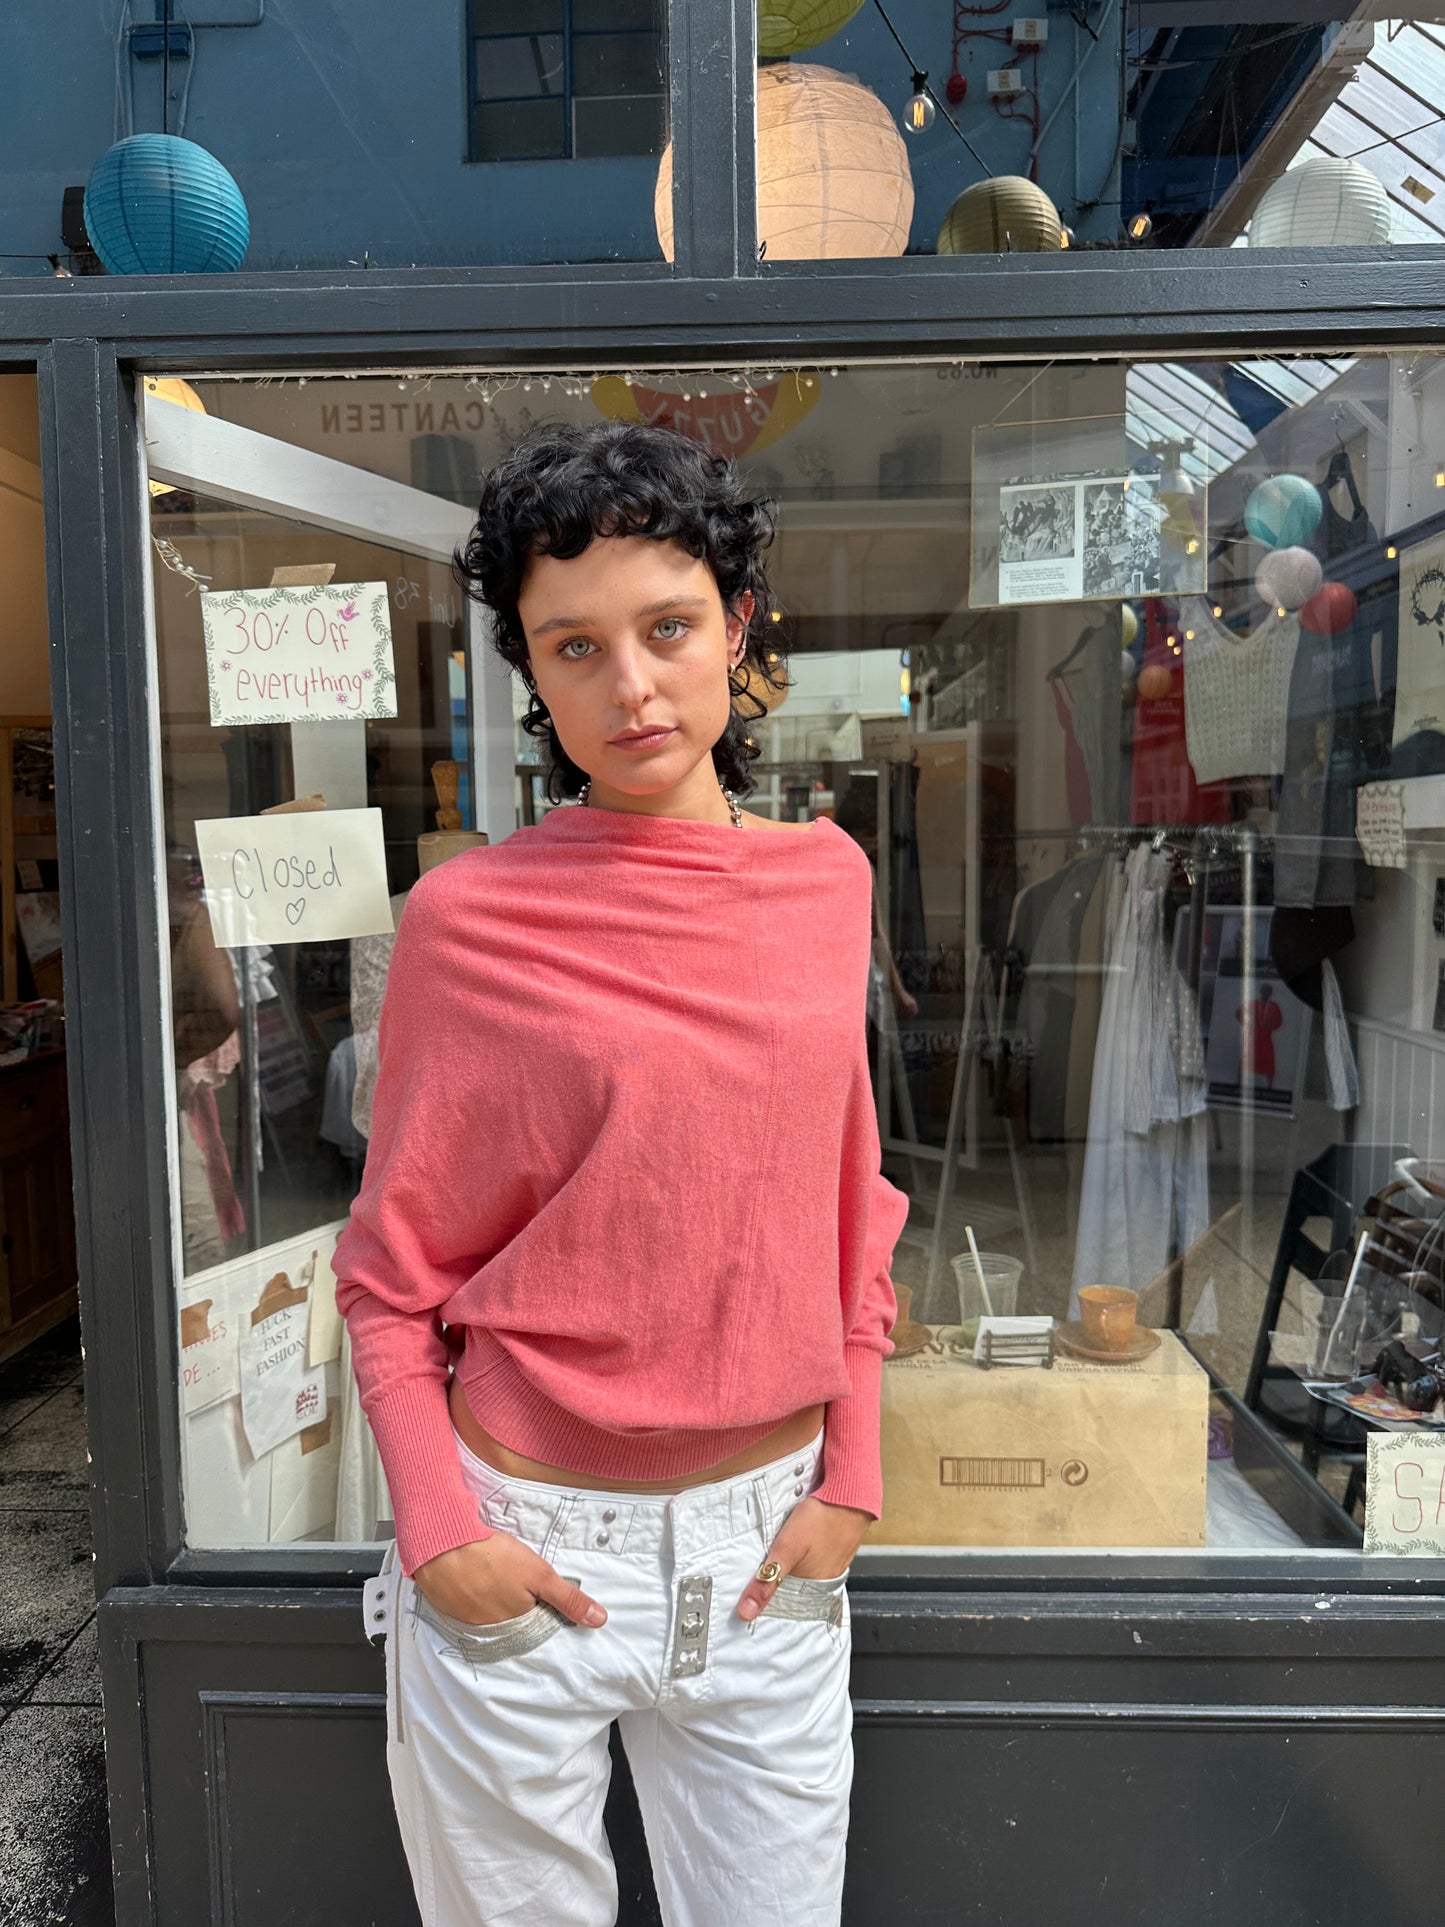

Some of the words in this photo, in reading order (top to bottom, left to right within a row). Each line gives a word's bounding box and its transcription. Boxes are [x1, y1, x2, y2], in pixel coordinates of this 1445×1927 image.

[224, 607, 289, 655] 30%
[305, 607, 350, 653] Off
[236, 667, 364, 711] everything
[231, 845, 342, 899] Closed
[255, 1337, 305, 1376] FASHION
[263, 1326, 291, 1352] FAST
